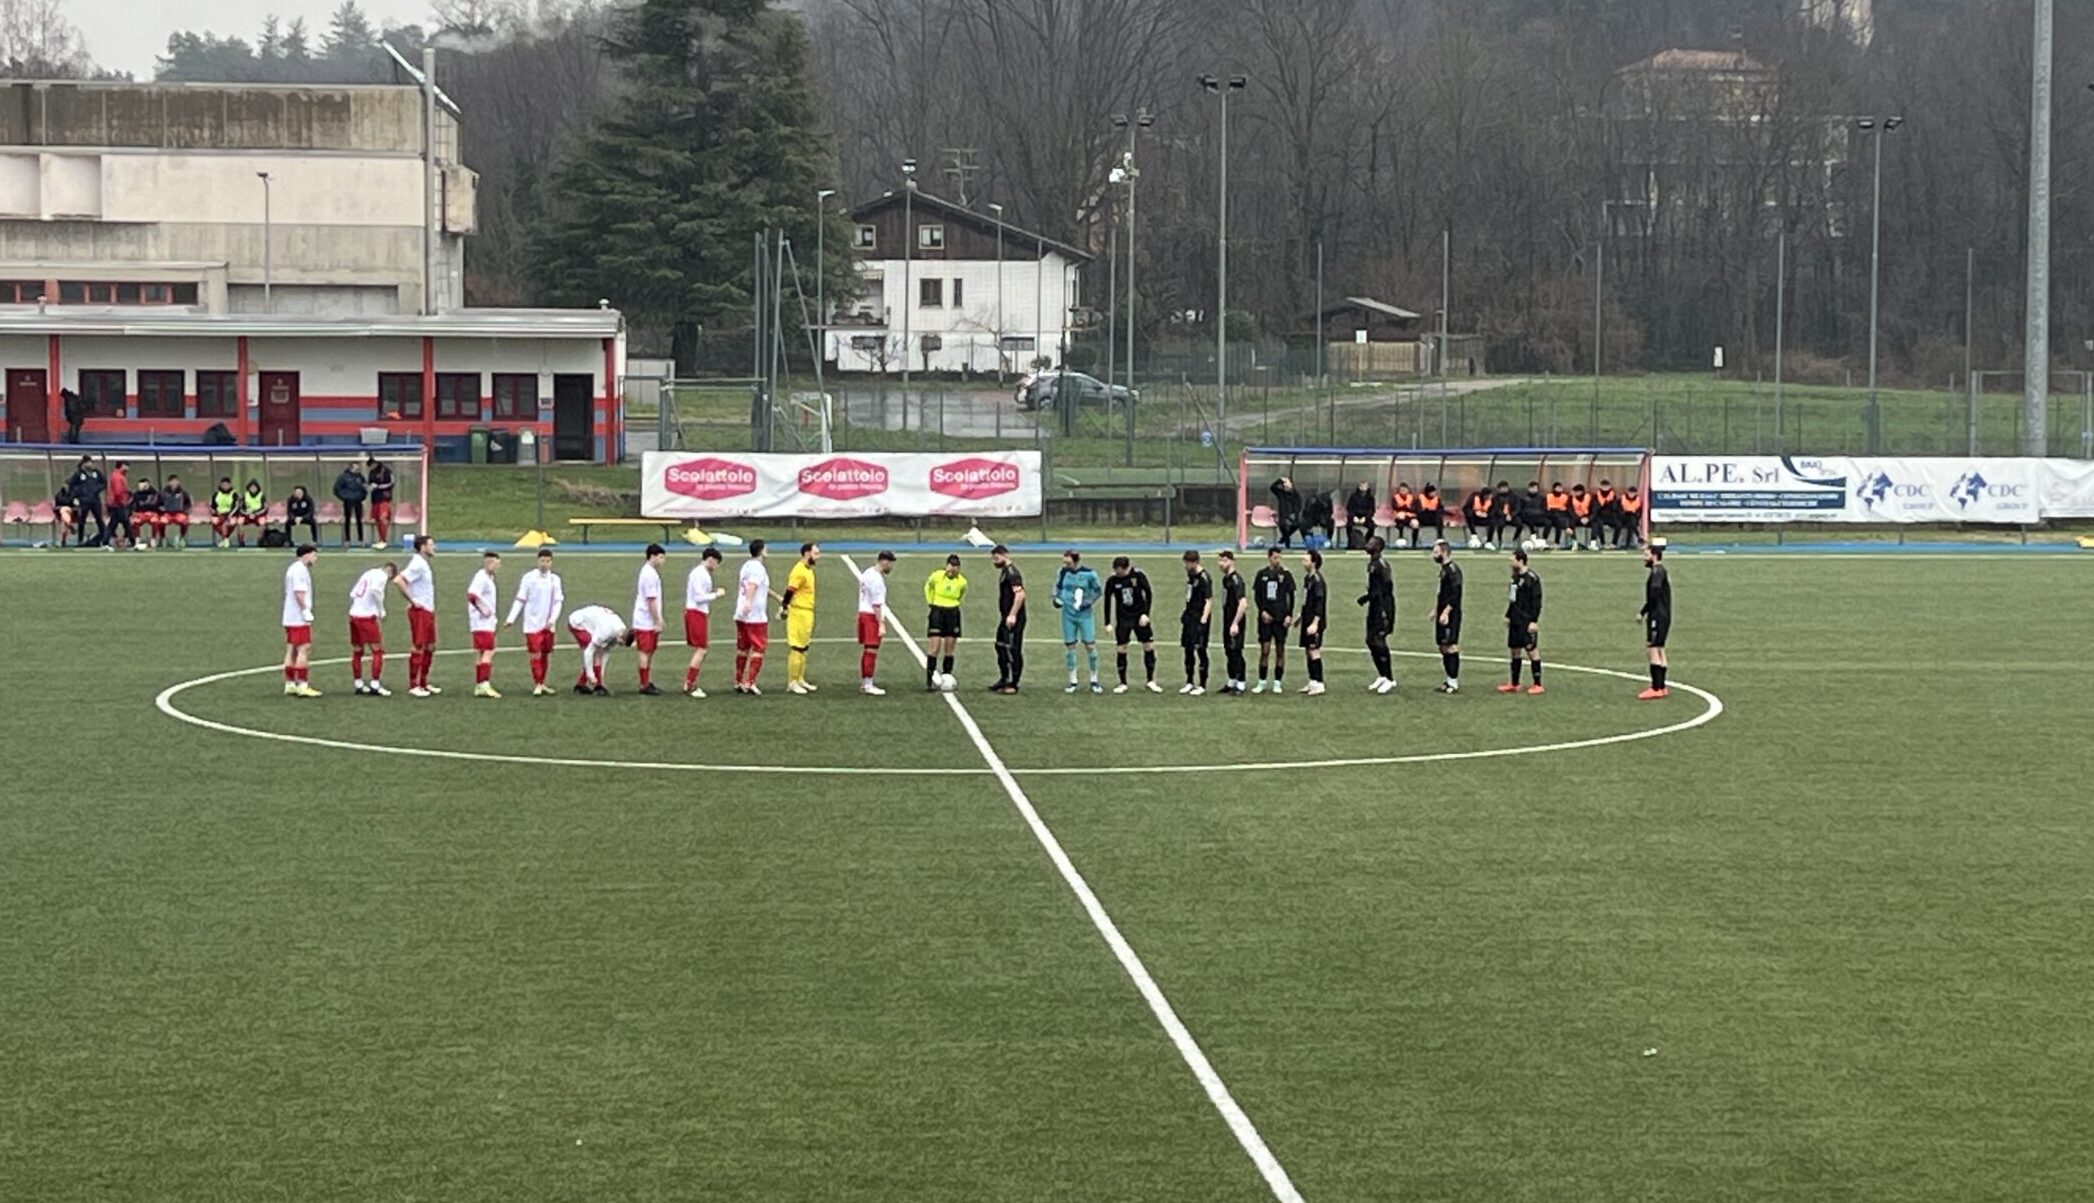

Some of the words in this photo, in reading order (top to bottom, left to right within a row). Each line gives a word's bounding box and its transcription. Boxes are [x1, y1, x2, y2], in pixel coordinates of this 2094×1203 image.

[1752, 466, 1779, 484] Srl
[1894, 484, 1930, 497] CDC
[1988, 484, 2024, 497] CDC
